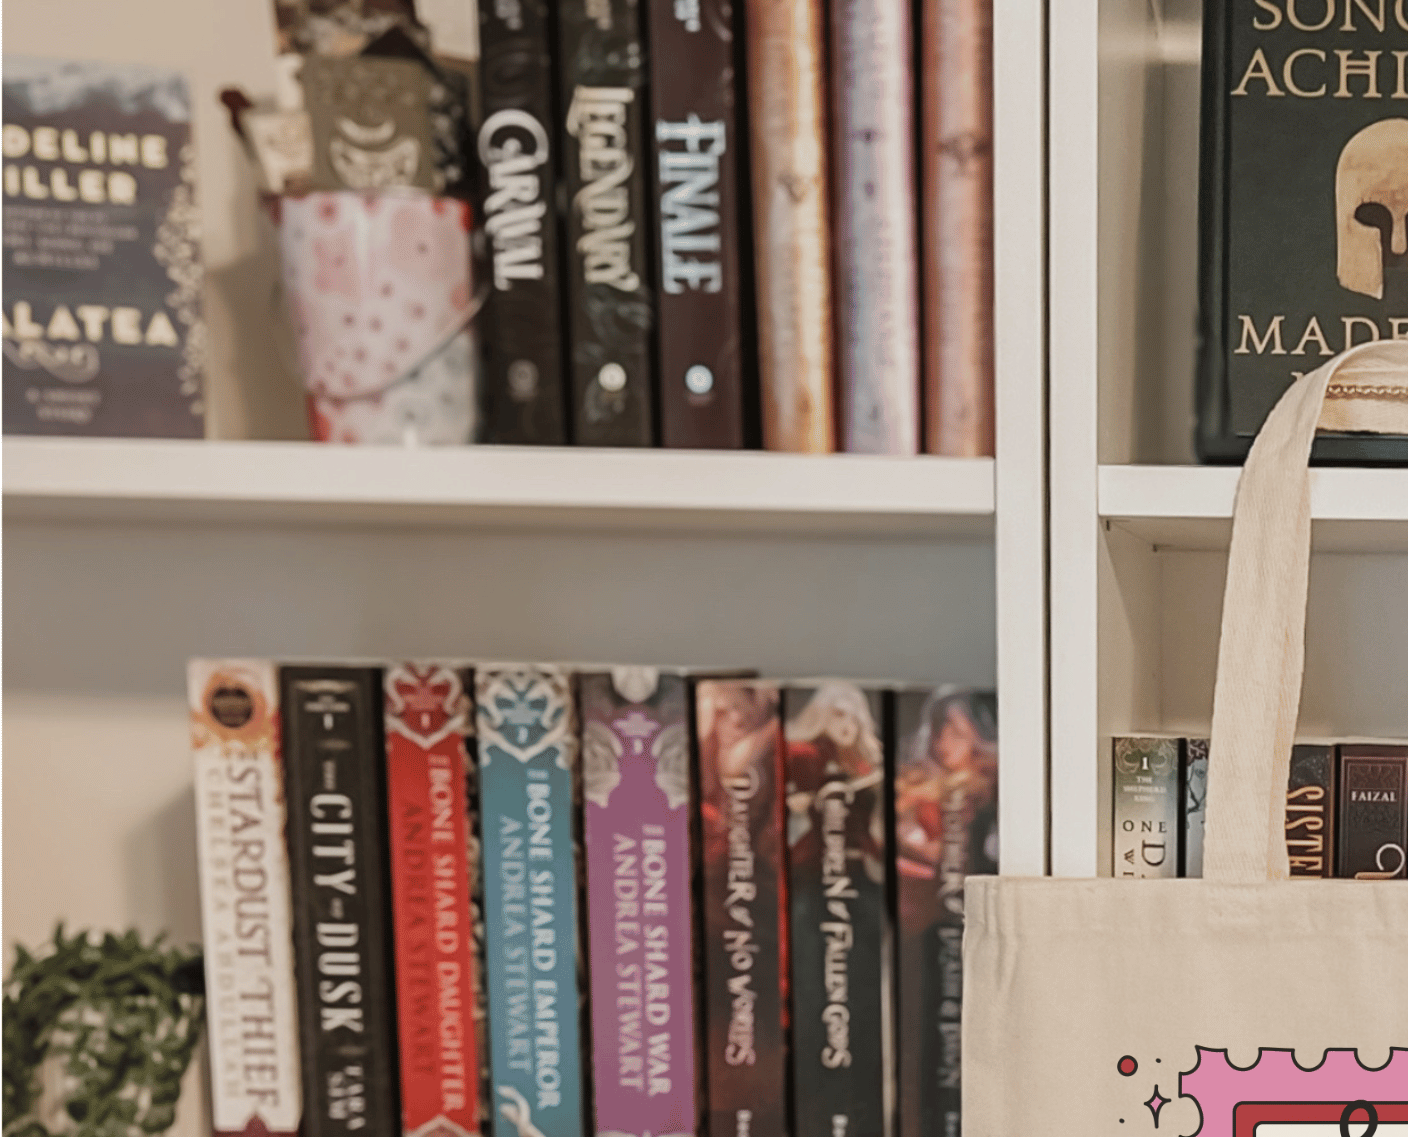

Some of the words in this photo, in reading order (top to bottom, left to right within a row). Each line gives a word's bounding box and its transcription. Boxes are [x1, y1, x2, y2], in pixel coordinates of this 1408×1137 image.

[655, 113, 726, 294] FINALE
[2, 300, 181, 348] LATEA
[309, 794, 358, 896] CITY
[427, 767, 456, 844] BONE
[526, 780, 556, 865] BONE
[1122, 819, 1168, 833] ONE
[1350, 790, 1398, 803] FAIZAL
[226, 760, 271, 967] STARDUST
[431, 852, 462, 956] SHARD
[498, 814, 529, 951] ANDREA
[611, 832, 640, 958] ANDREA
[642, 832, 669, 914] BONE
[529, 868, 558, 975] SHARD
[643, 920, 672, 1027] SHARD
[722, 927, 761, 977] NO
[819, 920, 856, 1000] FALLEN
[315, 922, 364, 1034] DUSK
[502, 955, 535, 1076] STEWART
[614, 964, 647, 1094] STEWART
[243, 982, 281, 1110] THIEF
[435, 959, 467, 1114] DAUGHTER
[532, 978, 563, 1111] EMPEROR
[646, 1031, 674, 1099] WAR
[819, 1003, 853, 1070] GODS
